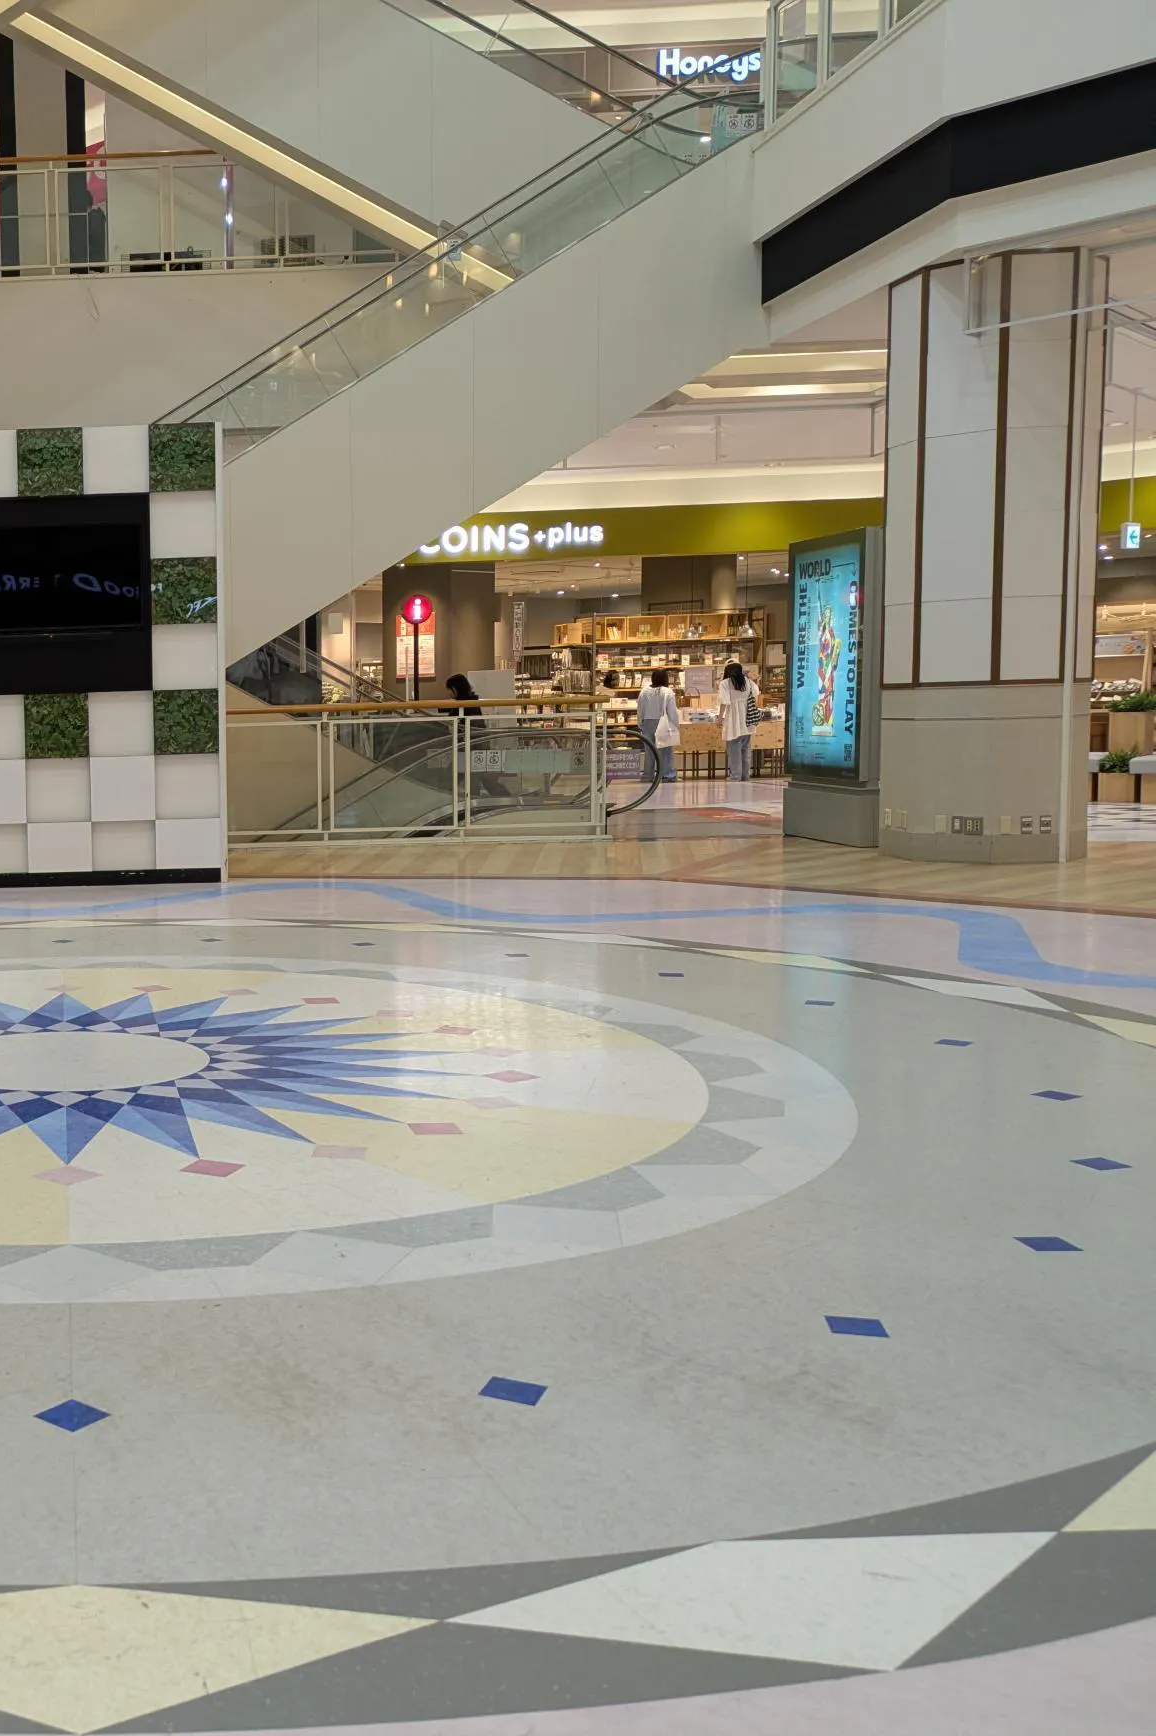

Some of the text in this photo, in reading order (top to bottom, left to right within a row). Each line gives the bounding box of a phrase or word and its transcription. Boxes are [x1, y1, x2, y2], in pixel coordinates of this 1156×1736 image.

[657, 48, 761, 83] Honeys
[420, 523, 530, 554] OINS
[799, 559, 831, 580] WORLD
[796, 582, 808, 689] WHERE THE
[847, 656, 856, 682] TO
[844, 686, 855, 736] PLAY
